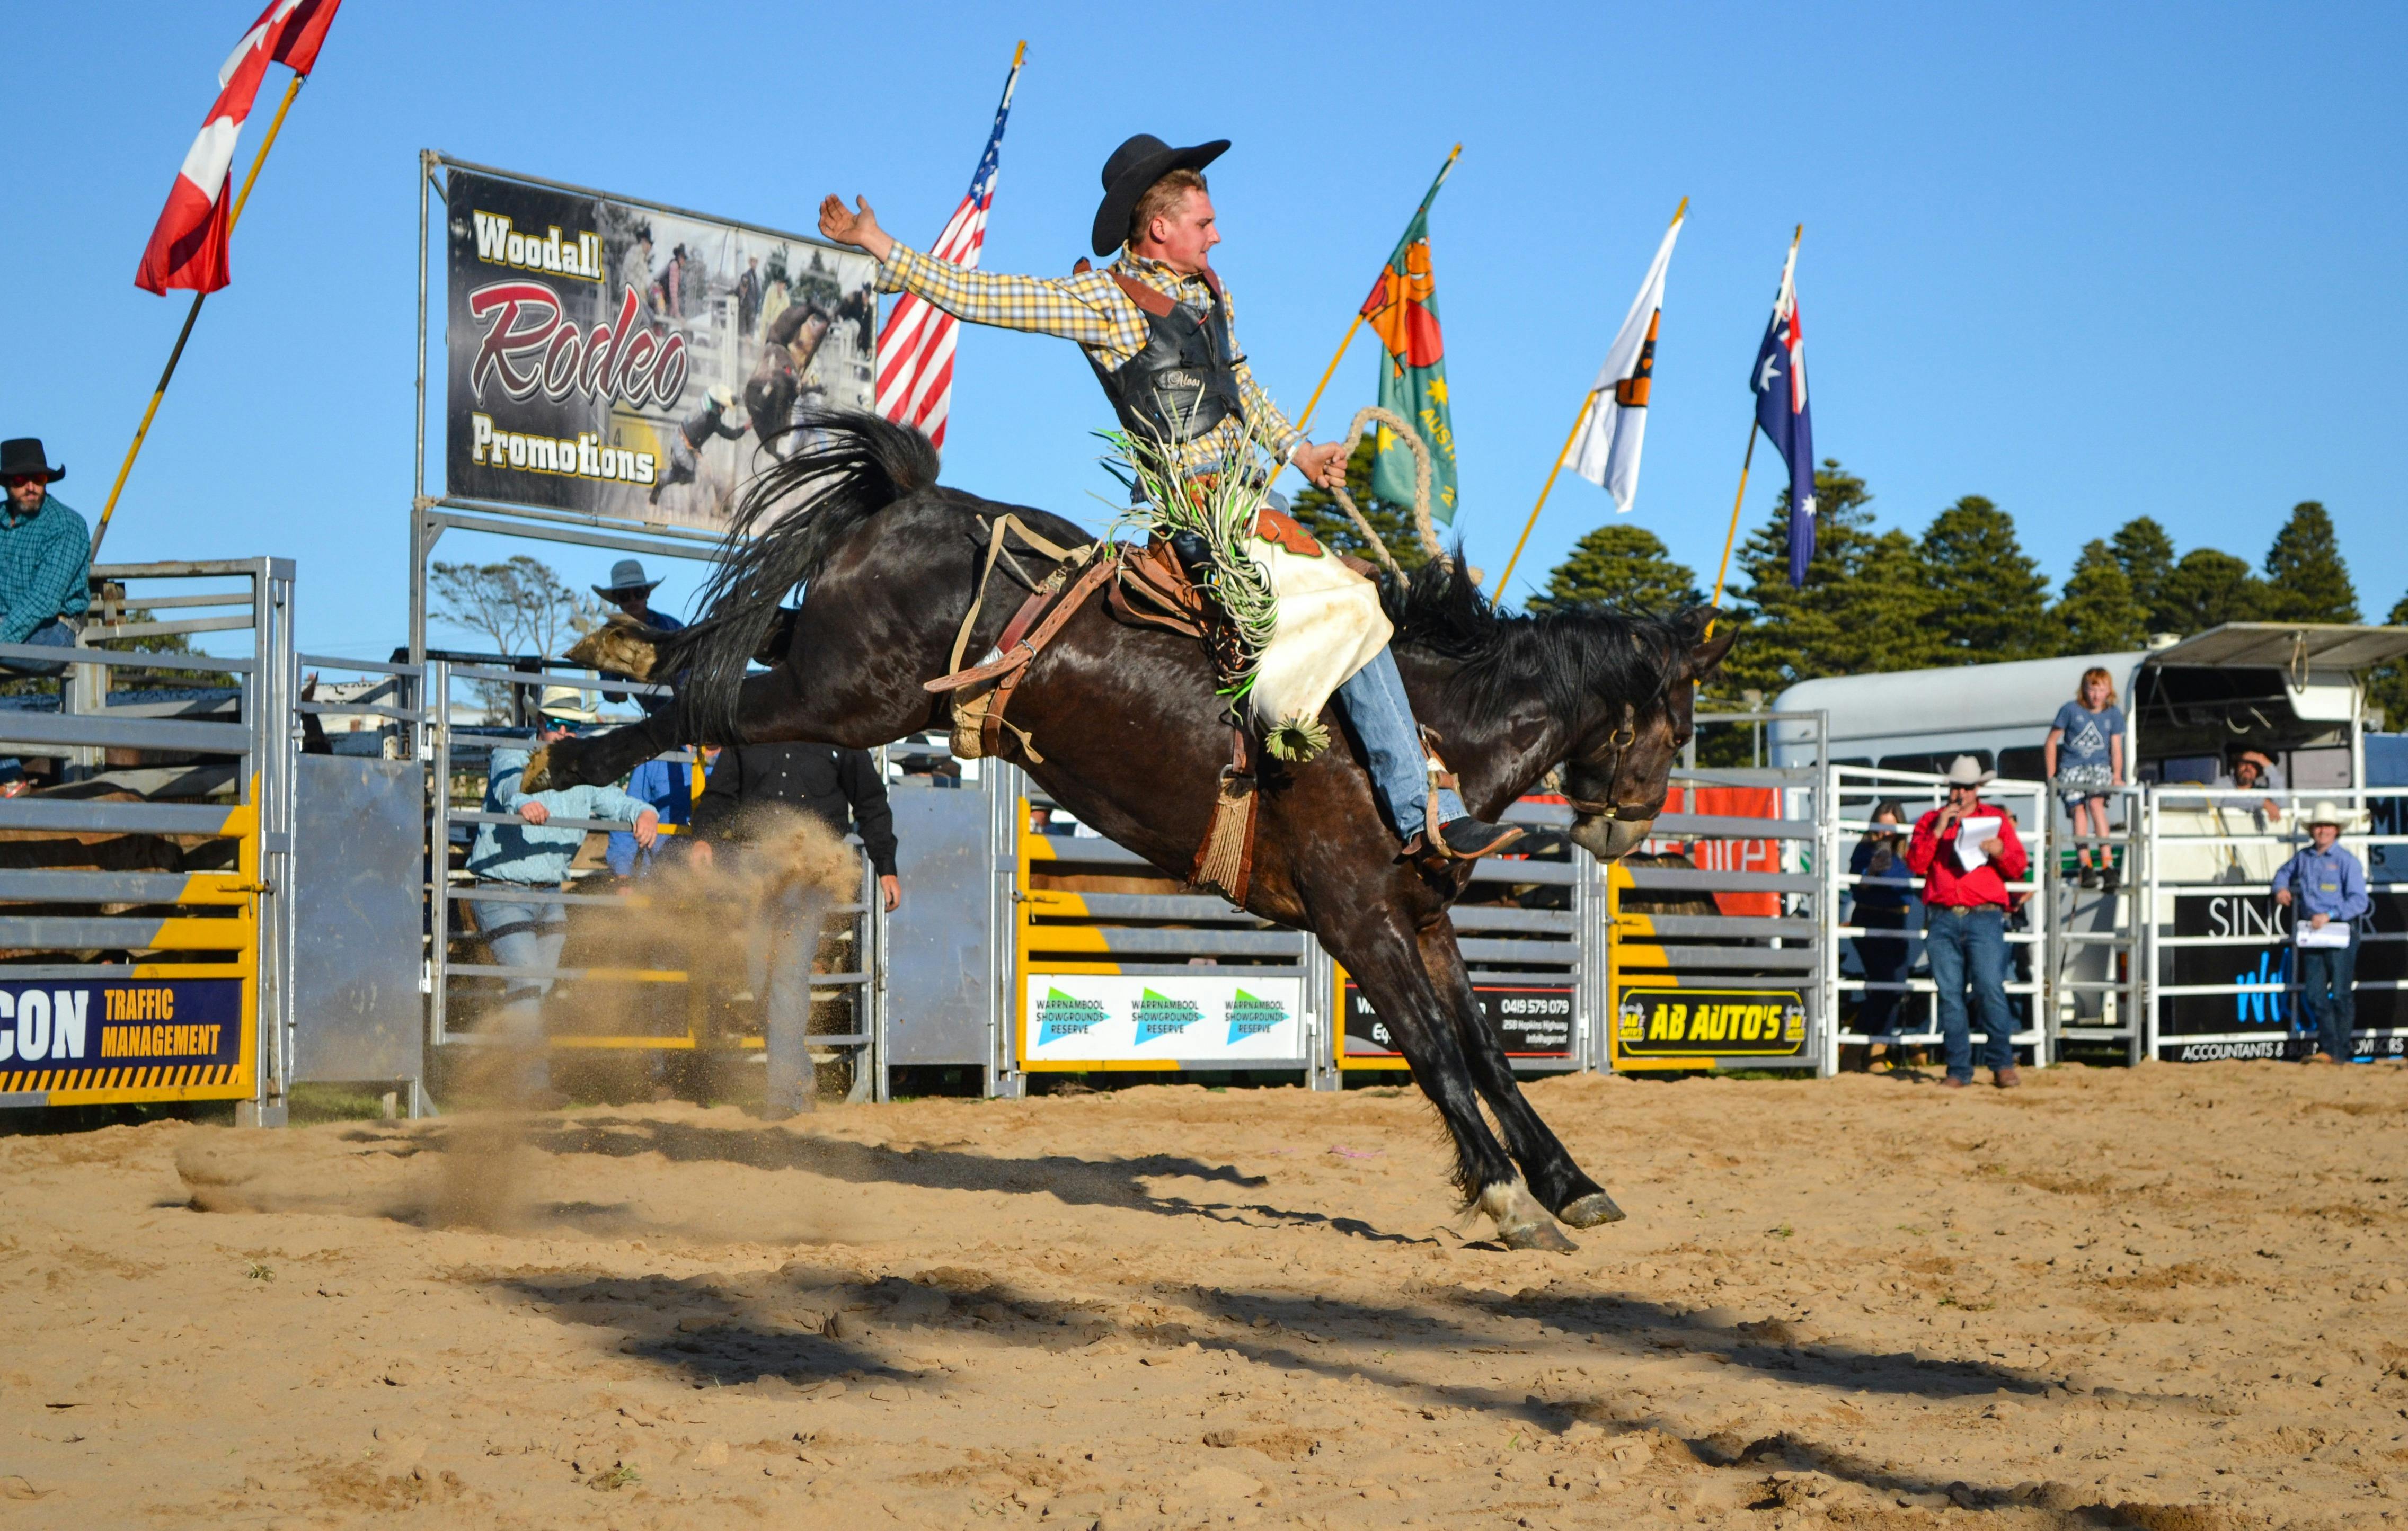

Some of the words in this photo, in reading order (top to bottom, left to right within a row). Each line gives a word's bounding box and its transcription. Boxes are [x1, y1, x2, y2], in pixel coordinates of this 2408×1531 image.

[474, 210, 604, 282] Woodall
[469, 281, 687, 411] Rodeo
[472, 413, 657, 487] Promotions
[104, 989, 174, 1021] TRAFFIC
[1036, 1000, 1104, 1009] WARRNAMBOOL
[1131, 1000, 1199, 1009] WARRNAMBOOL
[1225, 1000, 1285, 1010] WARRNAMBOOL
[1501, 999, 1527, 1014] 0419
[1527, 999, 1548, 1014] 579
[1548, 999, 1569, 1014] 079
[1036, 1012, 1104, 1022] SHOWGROUNDS
[1131, 1012, 1199, 1022] SHOWGROUNDS
[1225, 1012, 1285, 1021] SHOWGROUNDS
[1648, 1003, 1687, 1040] AB
[1688, 1004, 1782, 1040] AUTO'S
[1051, 1025, 1088, 1034] RESERVE
[1147, 1024, 1184, 1034] RESERVE
[1238, 1024, 1271, 1033] RESERVE
[101, 1025, 221, 1057] MANAGEMENT
[2181, 1042, 2273, 1060] ACCOUNTANTS
